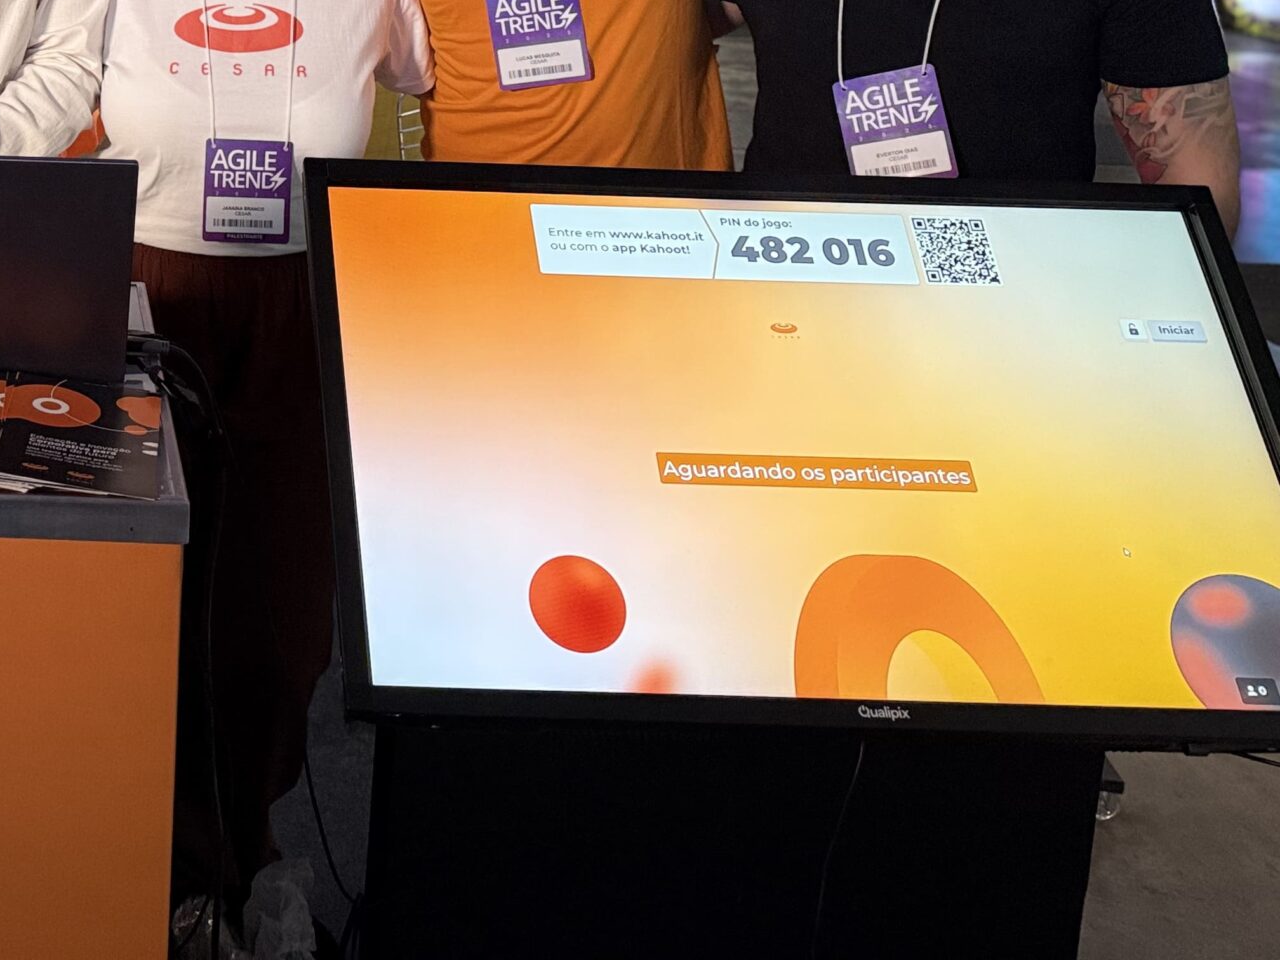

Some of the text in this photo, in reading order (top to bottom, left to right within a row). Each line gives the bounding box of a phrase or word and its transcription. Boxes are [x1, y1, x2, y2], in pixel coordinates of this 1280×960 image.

[845, 78, 923, 114] AGILE
[210, 148, 278, 171] AGILE
[720, 217, 793, 229] PIN do jogo:
[548, 227, 705, 242] Entre em www.kahoot.it
[550, 242, 691, 255] ou com o app Kahoot!
[731, 235, 896, 267] 482 016
[1158, 325, 1195, 335] Iniciar
[663, 460, 971, 486] Aguardando os participantes
[1257, 685, 1268, 696] 0
[857, 704, 911, 722] Qualipix
